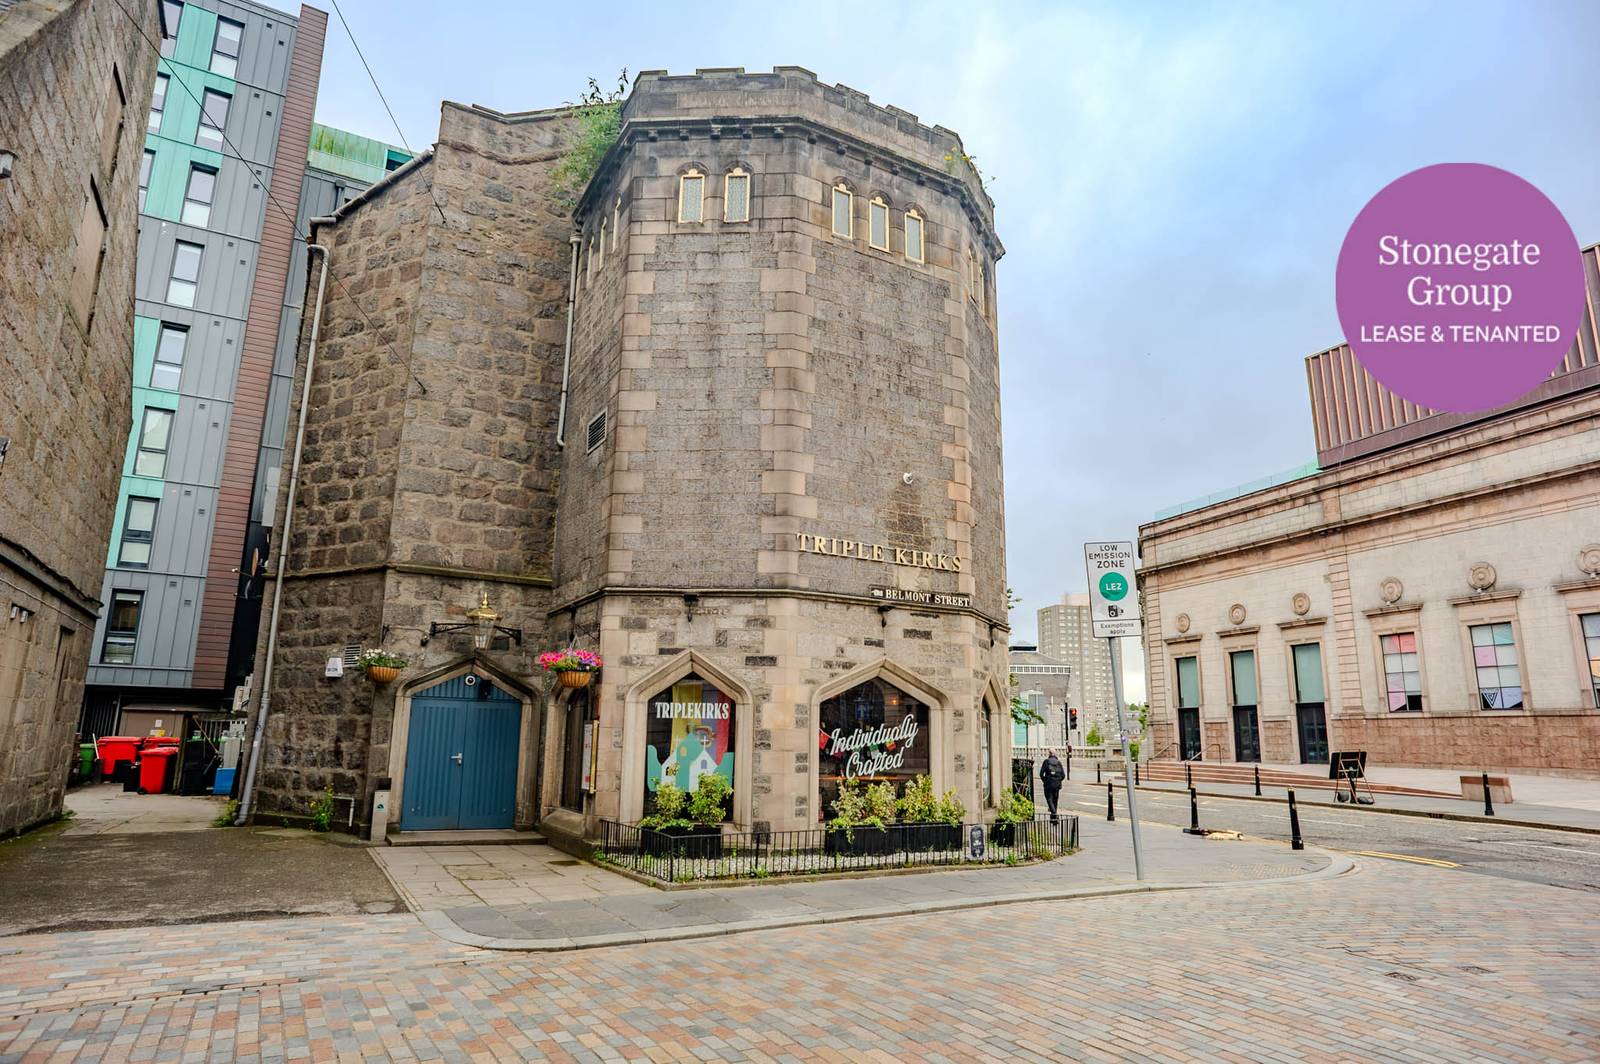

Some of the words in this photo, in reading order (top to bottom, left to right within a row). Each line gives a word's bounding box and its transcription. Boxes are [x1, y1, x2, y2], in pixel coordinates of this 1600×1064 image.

[796, 533, 885, 562] TRIPLE
[895, 547, 962, 572] KIRKS
[1100, 544, 1118, 552] LOW
[1088, 552, 1130, 560] EMISSION
[1097, 560, 1125, 568] ZONE
[1105, 583, 1122, 591] LEZ
[885, 589, 931, 603] BELMONT
[934, 594, 970, 607] STREET
[1100, 622, 1134, 630] Exemptions
[655, 702, 729, 719] TRIPLEKIRKS
[830, 714, 919, 756] Individually
[846, 746, 905, 780] Crafted
